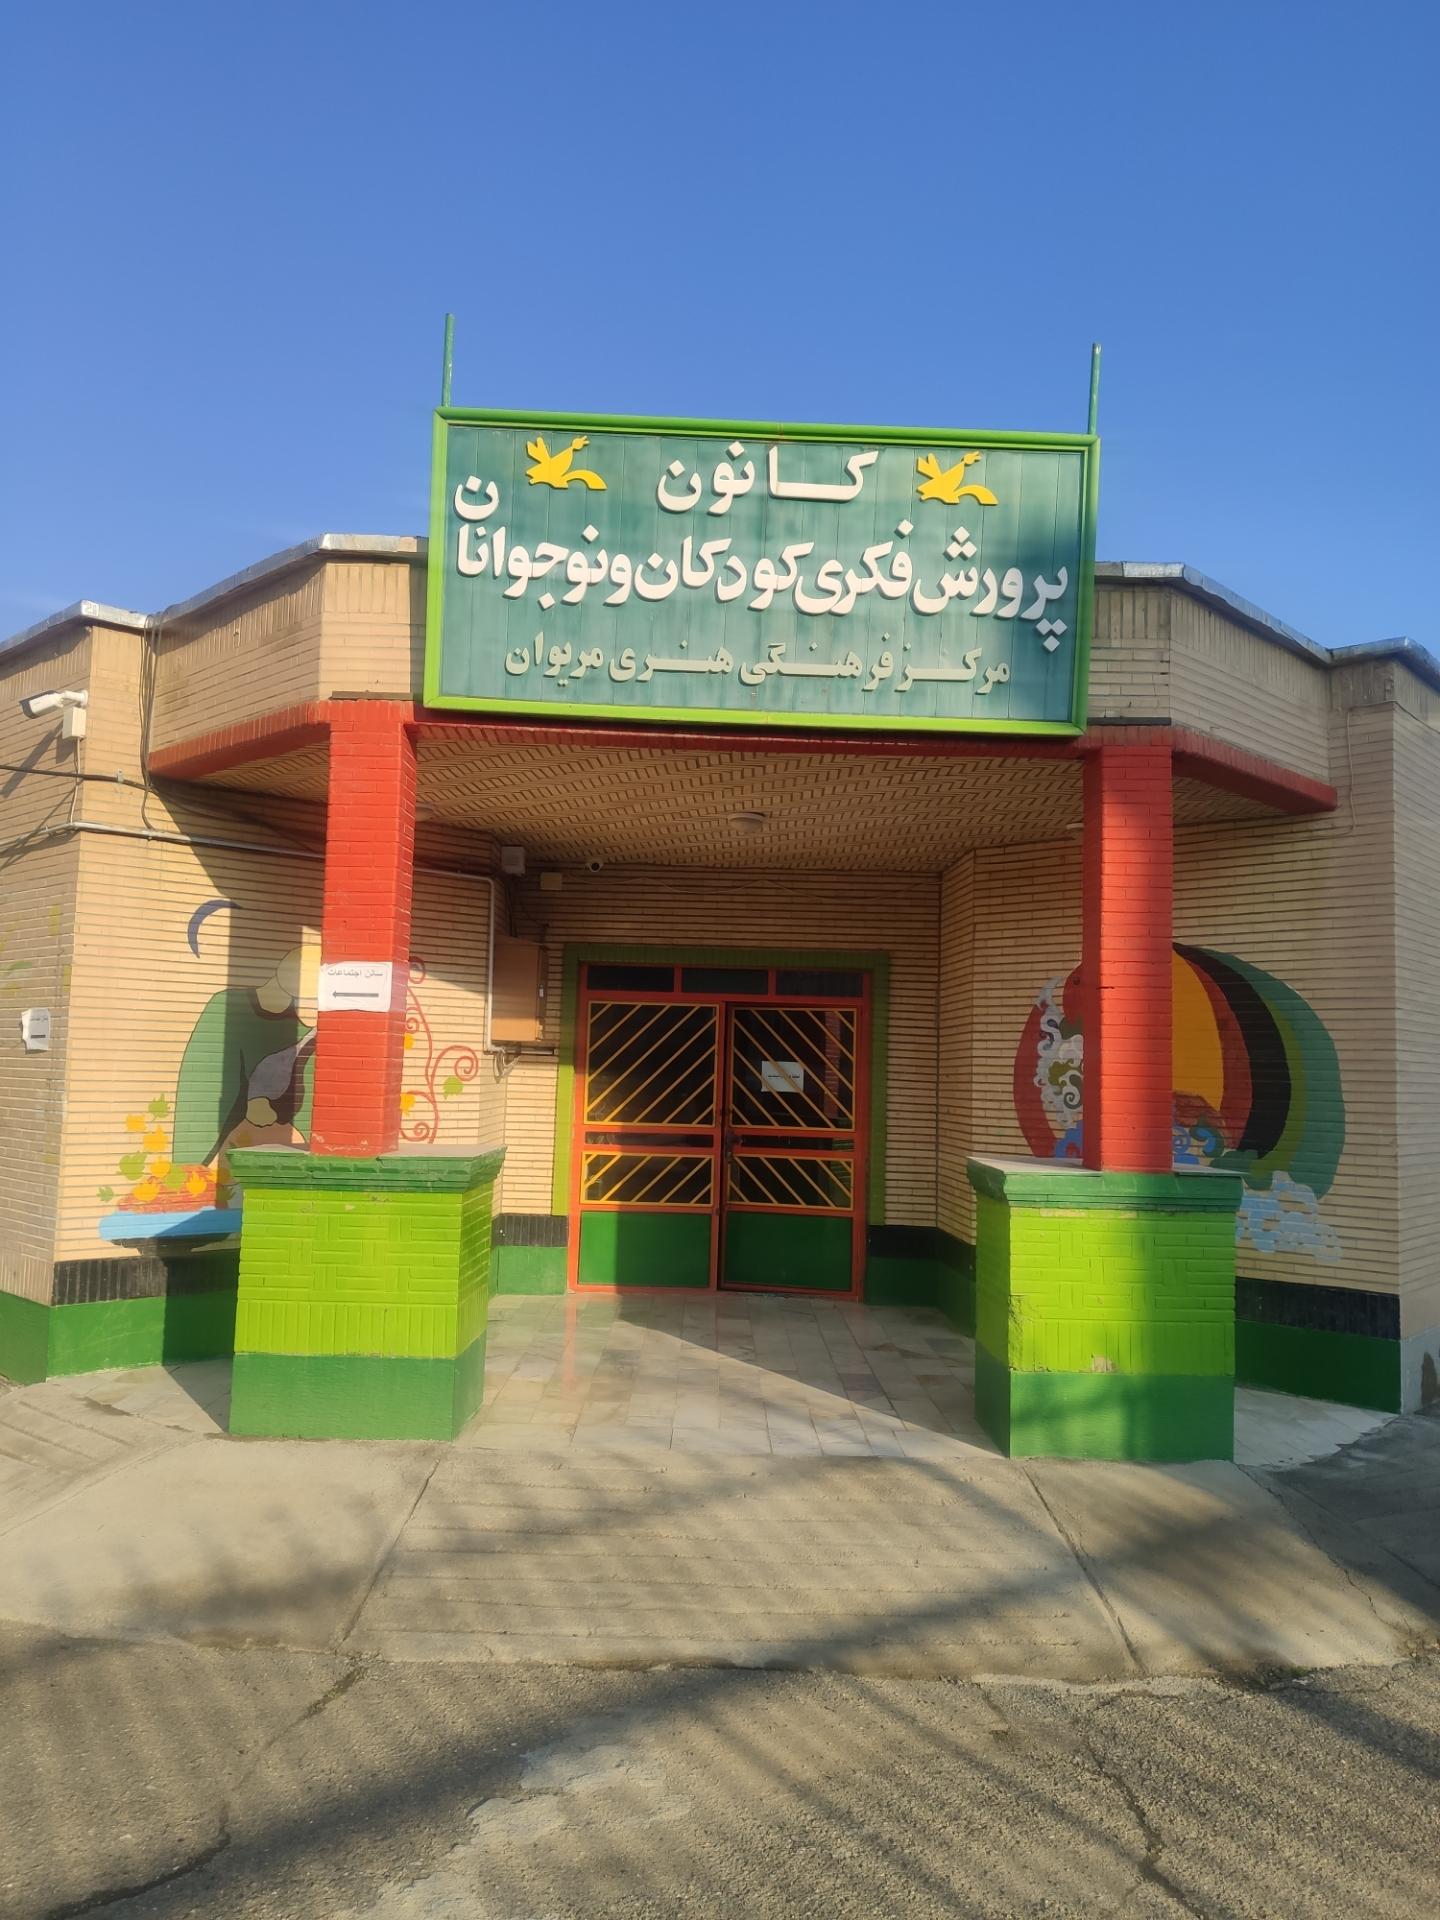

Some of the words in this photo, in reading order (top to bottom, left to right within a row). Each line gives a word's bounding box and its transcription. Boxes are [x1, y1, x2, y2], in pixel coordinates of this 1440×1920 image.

[656, 440, 879, 515] کانون
[634, 534, 815, 610] کودکان
[793, 519, 914, 616] فکری
[912, 525, 1069, 652] پرورش
[505, 631, 604, 687] مریوان
[608, 639, 735, 682] هنری
[738, 632, 894, 692] فرهنگی
[895, 641, 1010, 694] مرکز
